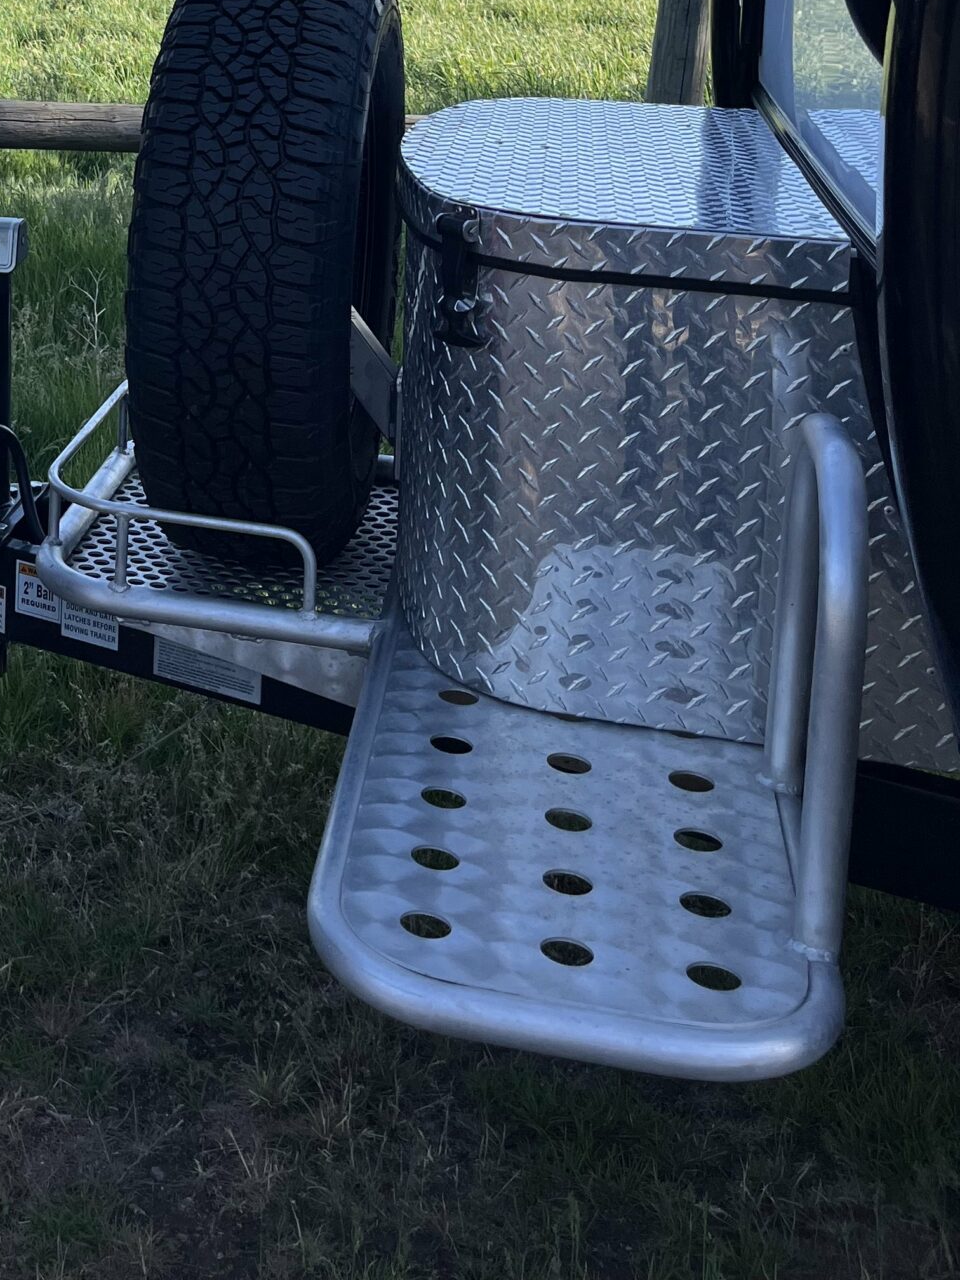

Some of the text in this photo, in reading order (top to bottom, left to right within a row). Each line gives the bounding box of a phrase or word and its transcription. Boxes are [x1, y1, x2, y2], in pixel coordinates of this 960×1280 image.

[36, 584, 54, 602] Ball
[21, 597, 57, 613] REQUIRED
[64, 613, 116, 633] LATCHES BEFORE
[64, 623, 116, 644] MOVING TRAILER
